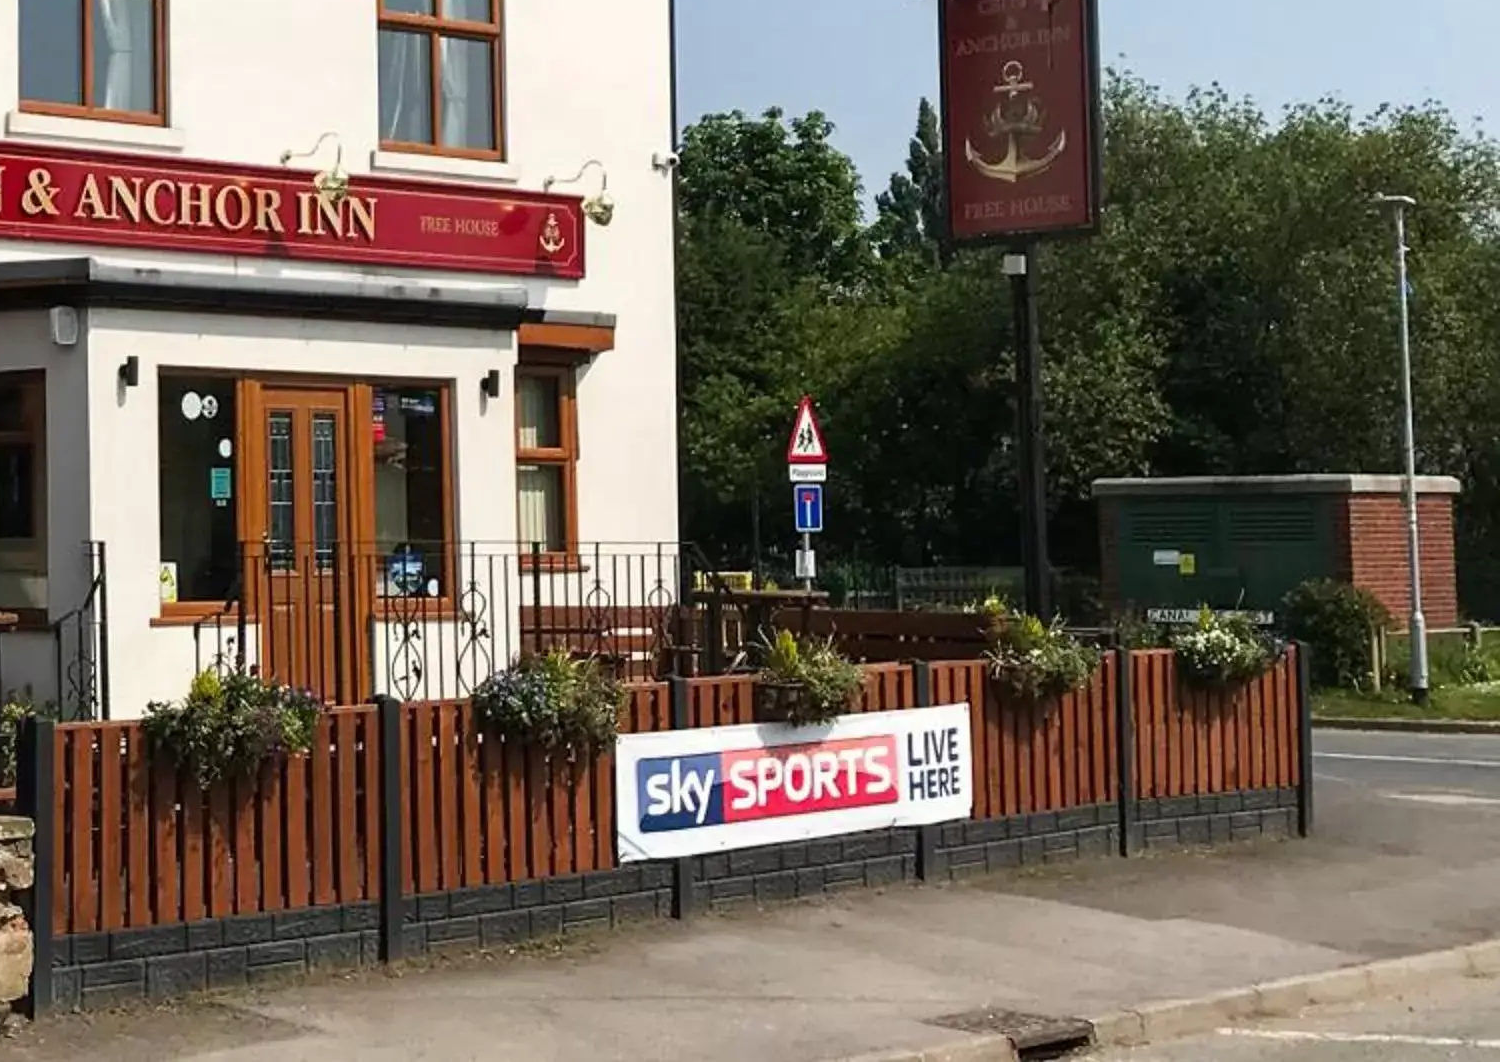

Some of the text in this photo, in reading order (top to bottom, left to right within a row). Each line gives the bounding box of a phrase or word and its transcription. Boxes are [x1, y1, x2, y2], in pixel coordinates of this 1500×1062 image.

[21, 168, 59, 215] &
[76, 173, 283, 233] ANCHOR
[297, 191, 378, 241] INN
[964, 194, 1073, 219] FREE HOUSE
[420, 215, 499, 237] FREE HOUSE
[908, 728, 958, 766] LIVE
[647, 747, 891, 824] sky SPORTS
[909, 766, 960, 800] HERE
